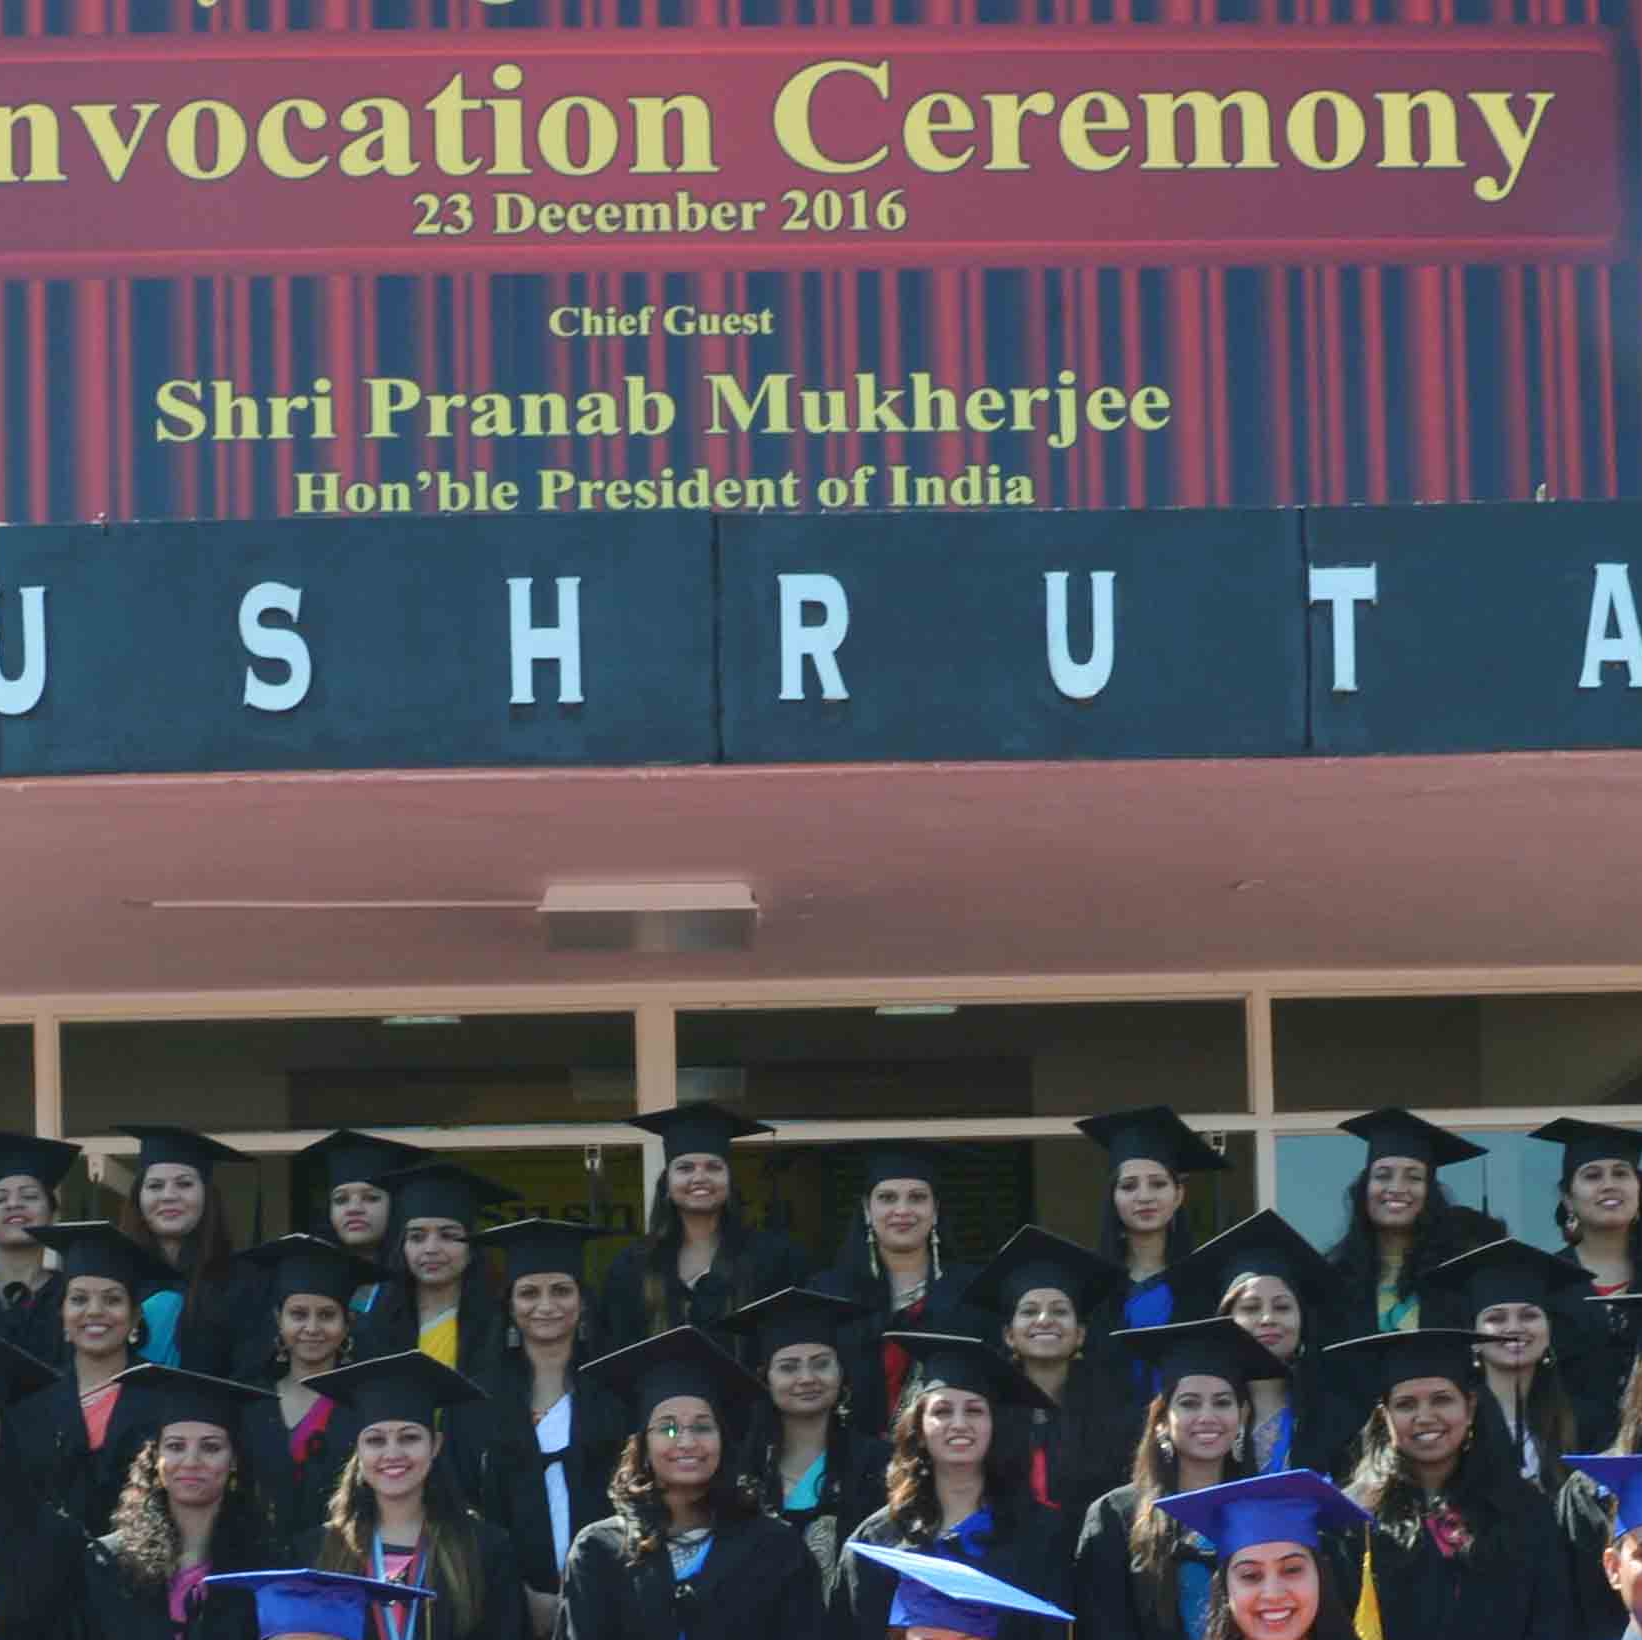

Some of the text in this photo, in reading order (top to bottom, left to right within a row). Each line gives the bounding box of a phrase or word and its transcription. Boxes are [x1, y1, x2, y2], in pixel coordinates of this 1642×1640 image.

[772, 60, 1555, 202] Ceremony
[412, 190, 907, 235] 23 December 2016
[548, 305, 775, 338] Chief Guest
[155, 370, 1172, 449] Shri Pranab Mukherjee
[294, 464, 1036, 514] Hon'ble President of India
